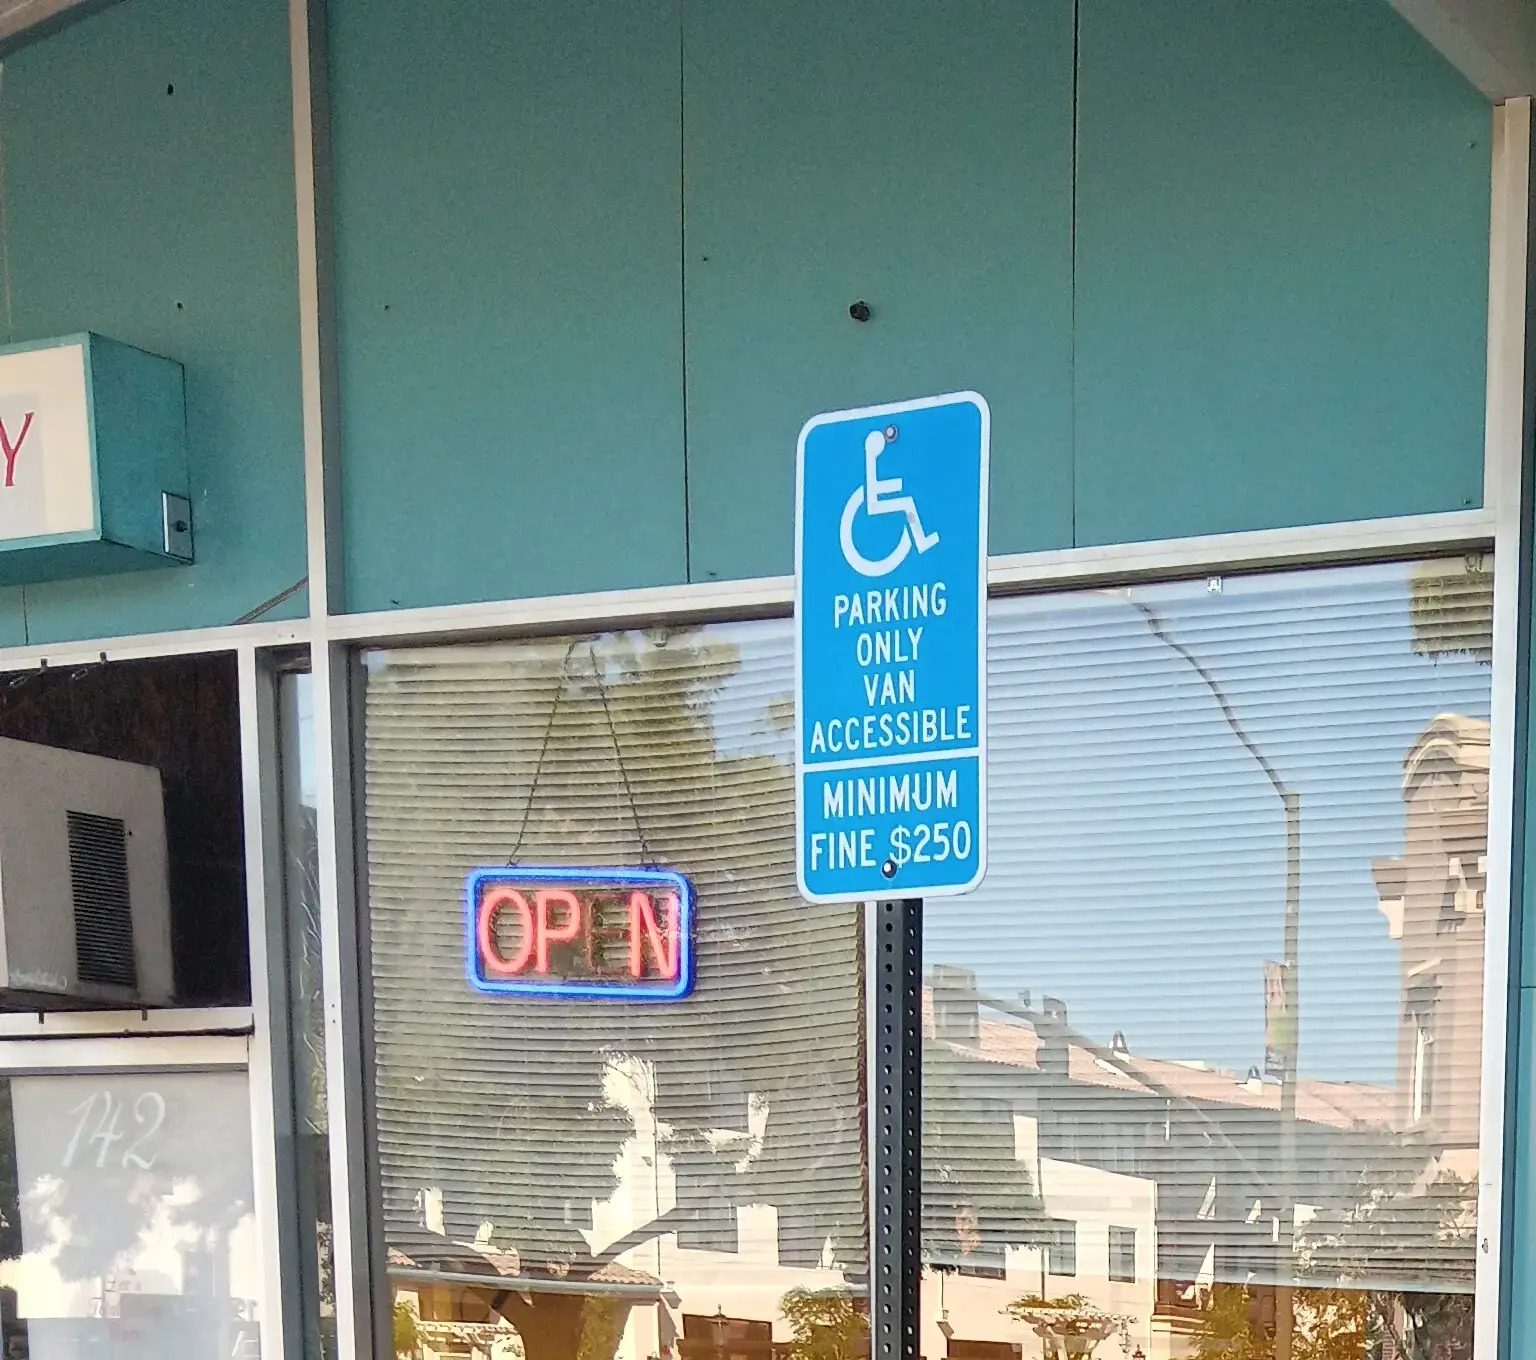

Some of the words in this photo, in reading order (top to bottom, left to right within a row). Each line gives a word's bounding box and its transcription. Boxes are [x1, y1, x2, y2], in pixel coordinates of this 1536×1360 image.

[834, 580, 948, 629] PARKING
[856, 626, 925, 667] ONLY
[863, 669, 916, 708] VAN
[810, 704, 972, 754] ACCESSIBLE
[822, 770, 958, 820] MINIMUM
[810, 829, 876, 871] FINE
[889, 820, 972, 868] $250
